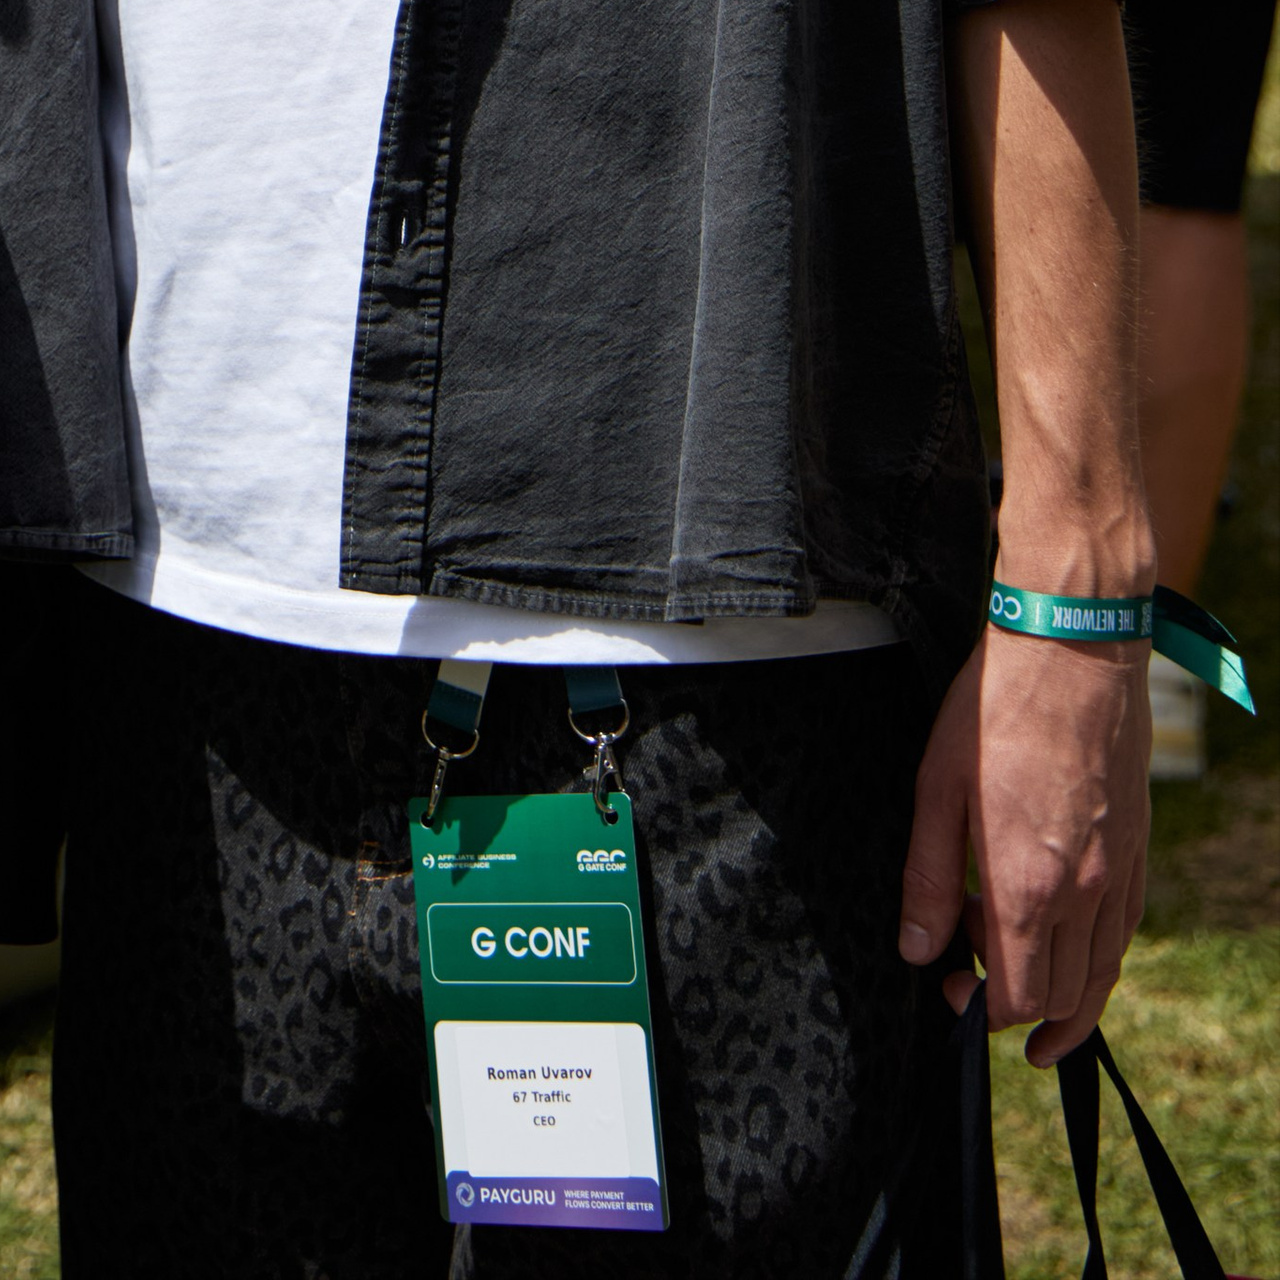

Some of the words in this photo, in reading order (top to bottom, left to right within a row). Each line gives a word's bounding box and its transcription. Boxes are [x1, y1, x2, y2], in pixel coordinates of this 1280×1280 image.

[989, 590, 1023, 622] CO
[1051, 604, 1117, 633] NETWORK
[1118, 608, 1136, 632] THE
[437, 853, 476, 861] AFFILIATE
[477, 853, 517, 861] BUSINESS
[585, 863, 605, 872] GATE
[605, 862, 627, 872] CONF
[471, 926, 497, 958] G
[504, 926, 591, 958] CONF
[487, 1066, 537, 1081] Roman
[541, 1066, 593, 1080] Uvarov
[512, 1091, 528, 1103] 67
[531, 1090, 572, 1103] Traffic
[532, 1115, 557, 1127] CEO
[480, 1187, 556, 1206] PAYGURU
[563, 1189, 590, 1200] WHERE
[590, 1190, 625, 1201] PAYMENT
[564, 1199, 591, 1210] FLOWS
[590, 1200, 626, 1211] CONVERT
[626, 1202, 655, 1212] BETTER
